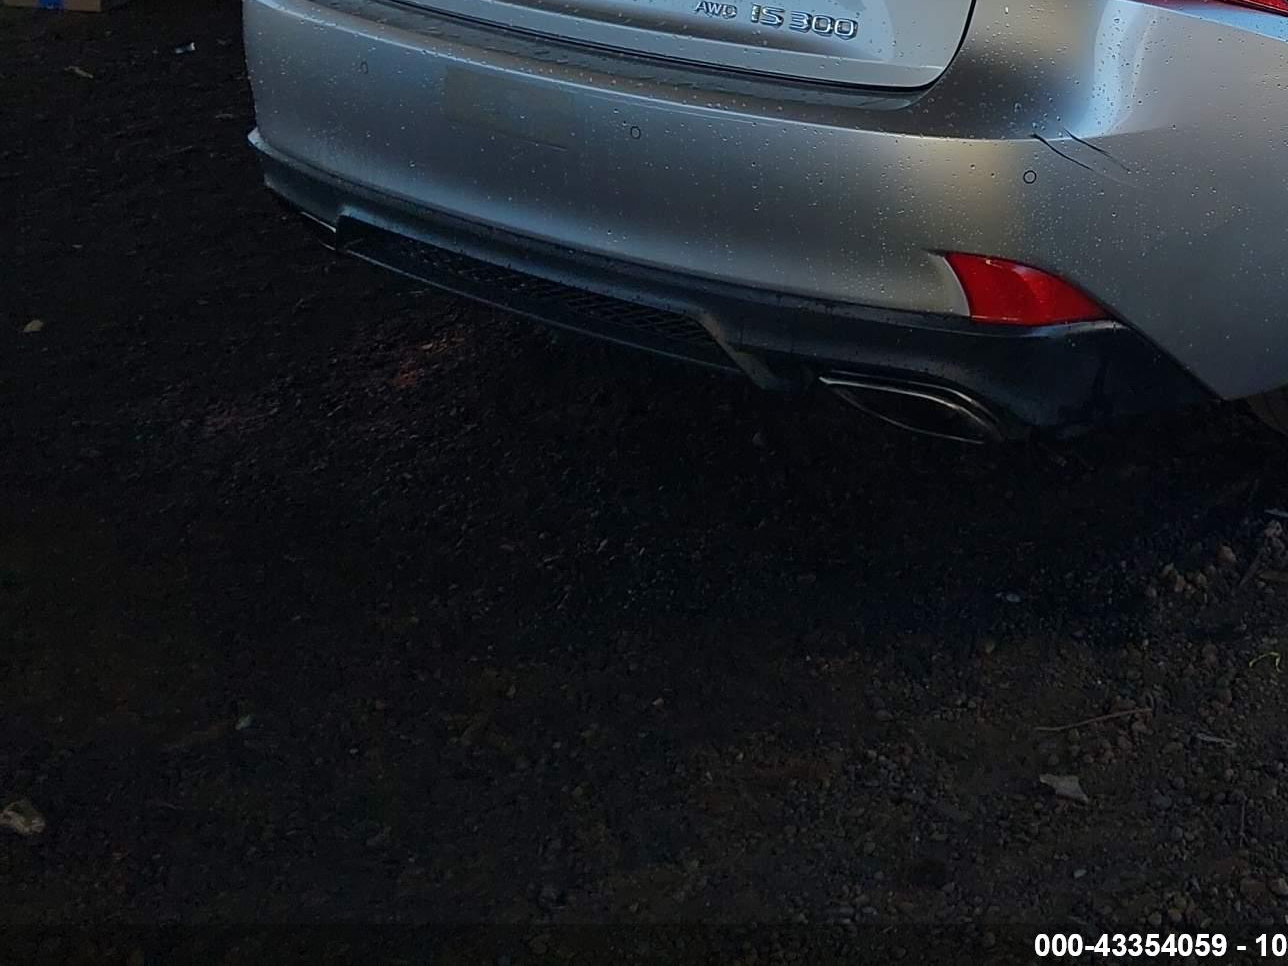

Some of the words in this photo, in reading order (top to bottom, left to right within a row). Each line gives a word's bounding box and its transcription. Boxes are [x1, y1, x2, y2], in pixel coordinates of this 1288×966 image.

[694, 0, 738, 19] AWD
[750, 3, 785, 28] IS
[788, 10, 859, 40] 300
